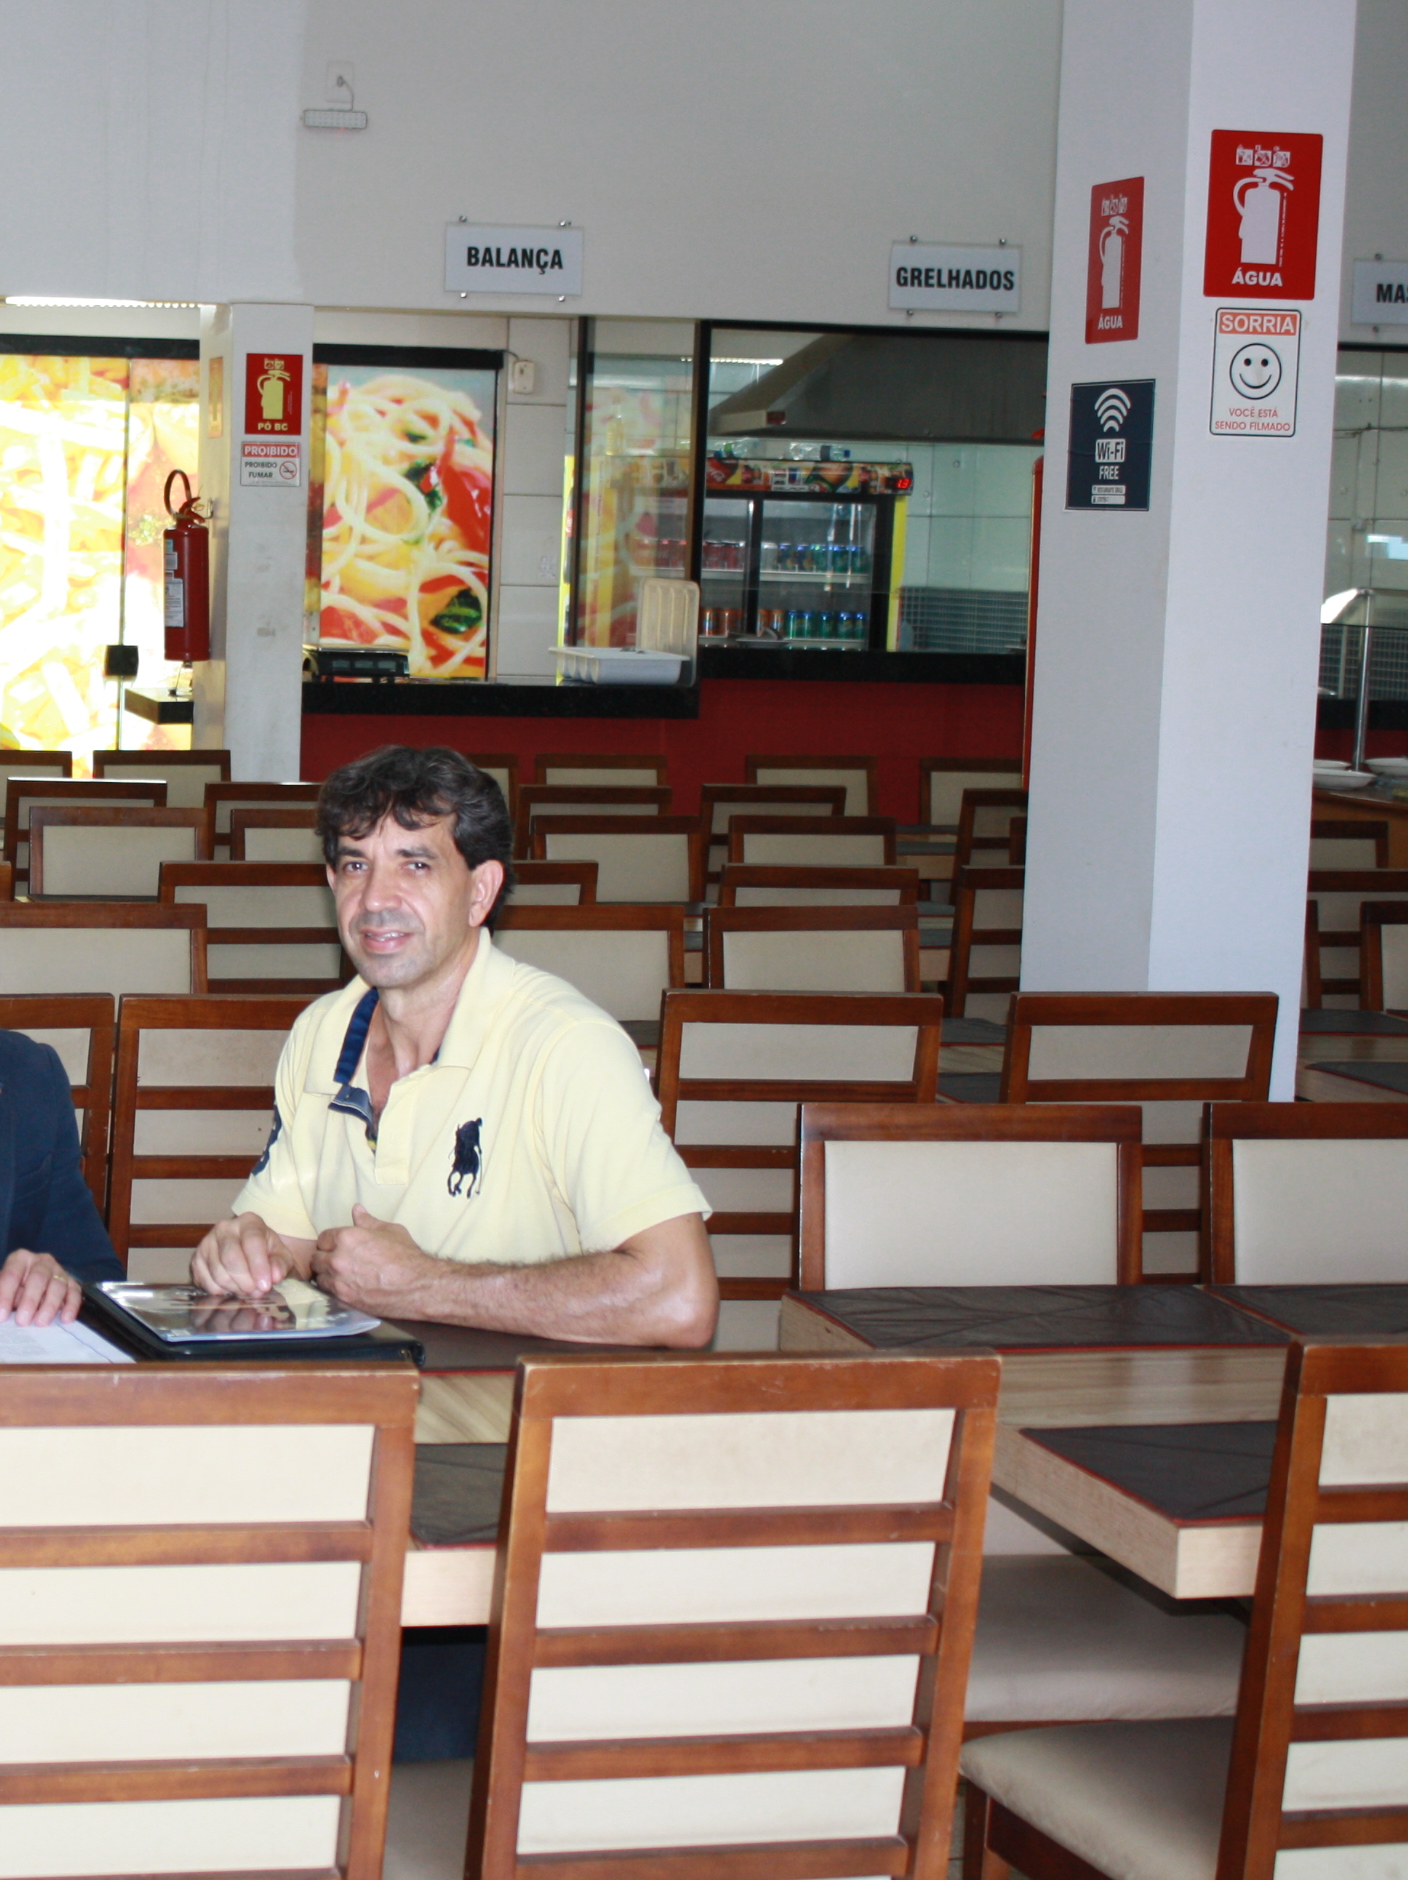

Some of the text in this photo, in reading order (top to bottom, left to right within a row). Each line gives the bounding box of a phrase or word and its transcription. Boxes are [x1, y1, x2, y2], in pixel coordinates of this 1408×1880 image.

[467, 246, 563, 275] BALANÇA
[896, 266, 1015, 291] GRELHADOS
[1231, 267, 1283, 287] ÁGUA
[1376, 283, 1408, 304] MA
[1098, 313, 1123, 330] ÁGUA
[1221, 314, 1295, 334] SORRIA
[1229, 406, 1279, 418] VOCÊ ESTÁ
[258, 421, 288, 431] PÓ BC
[1215, 421, 1291, 431] SENDO FILMADO
[244, 446, 298, 456] PROIBIDO
[1097, 441, 1124, 461] Wi-Fi
[1099, 465, 1120, 480] FREE
